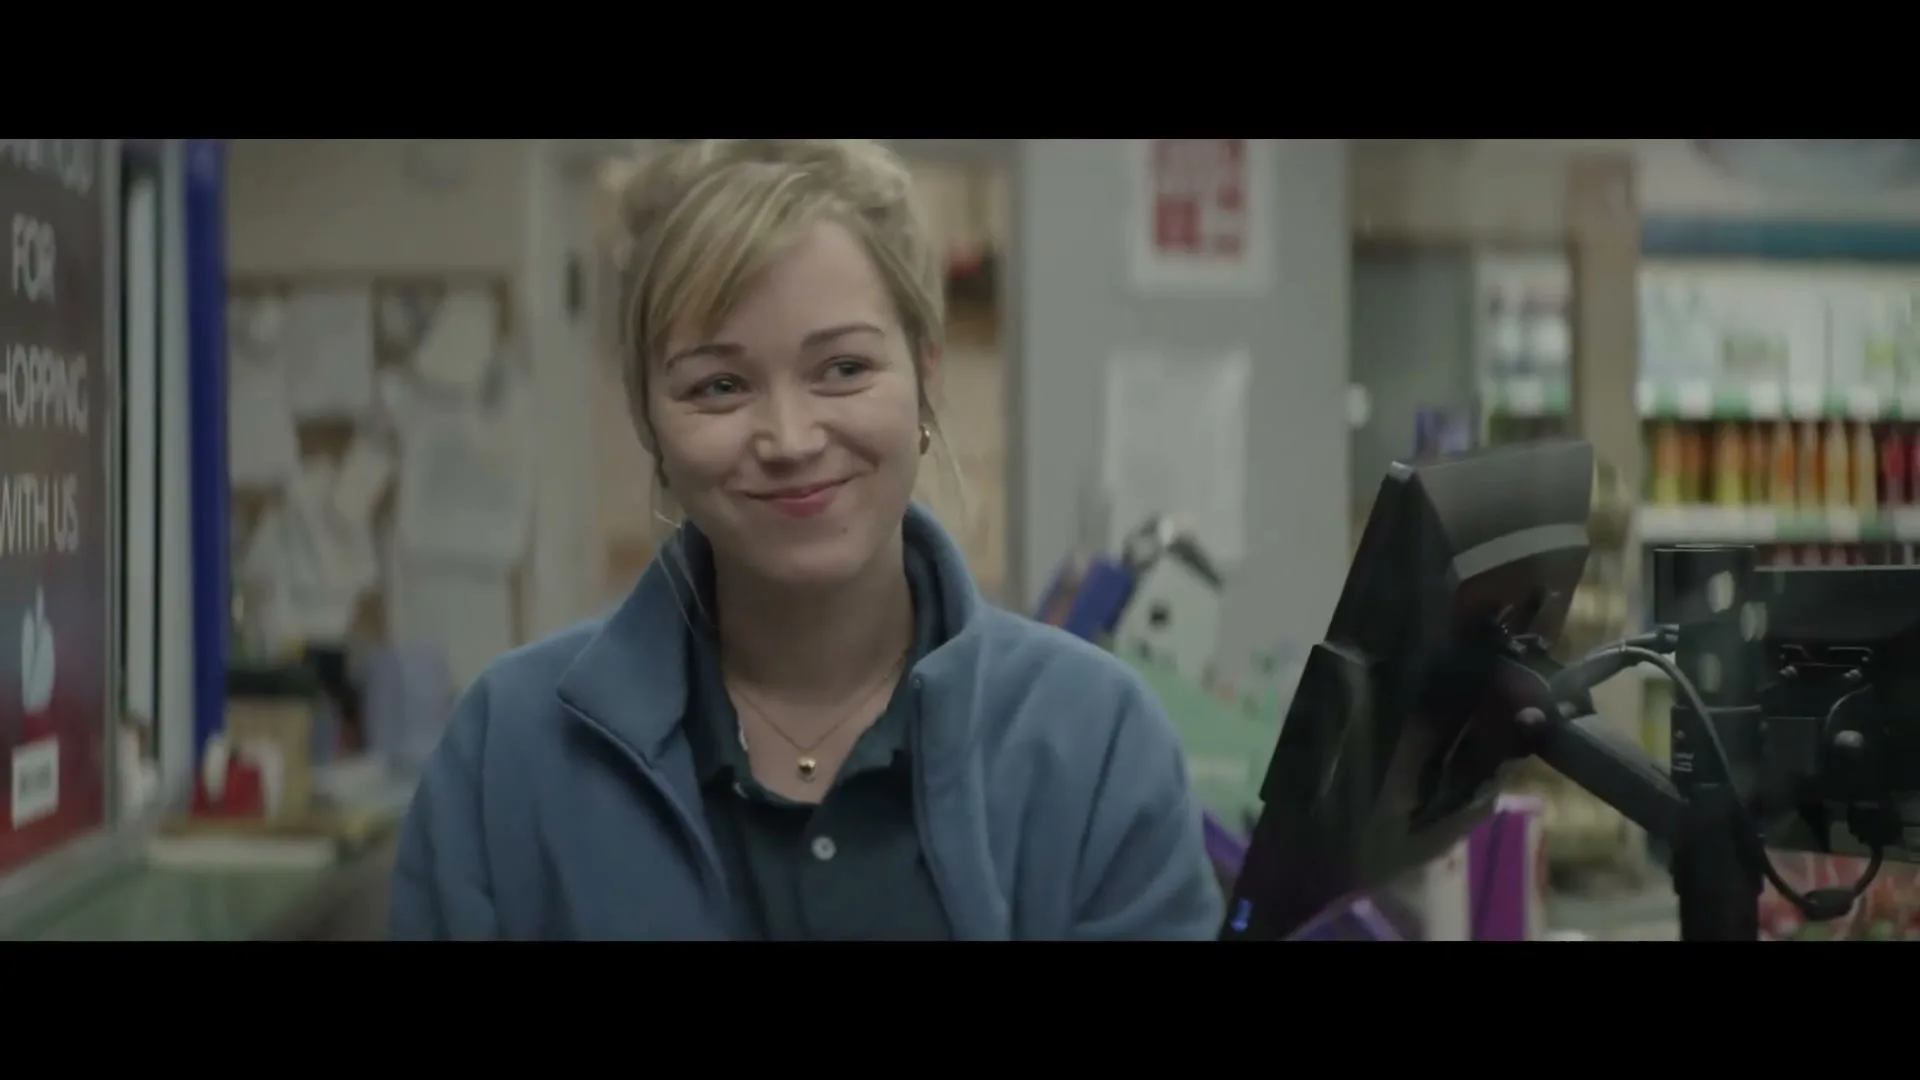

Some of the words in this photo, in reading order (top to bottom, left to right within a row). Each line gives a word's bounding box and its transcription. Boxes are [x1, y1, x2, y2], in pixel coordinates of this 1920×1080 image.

[12, 212, 56, 301] FOR
[0, 342, 89, 435] HOPPING
[0, 471, 49, 557] WITH
[53, 473, 78, 553] US
